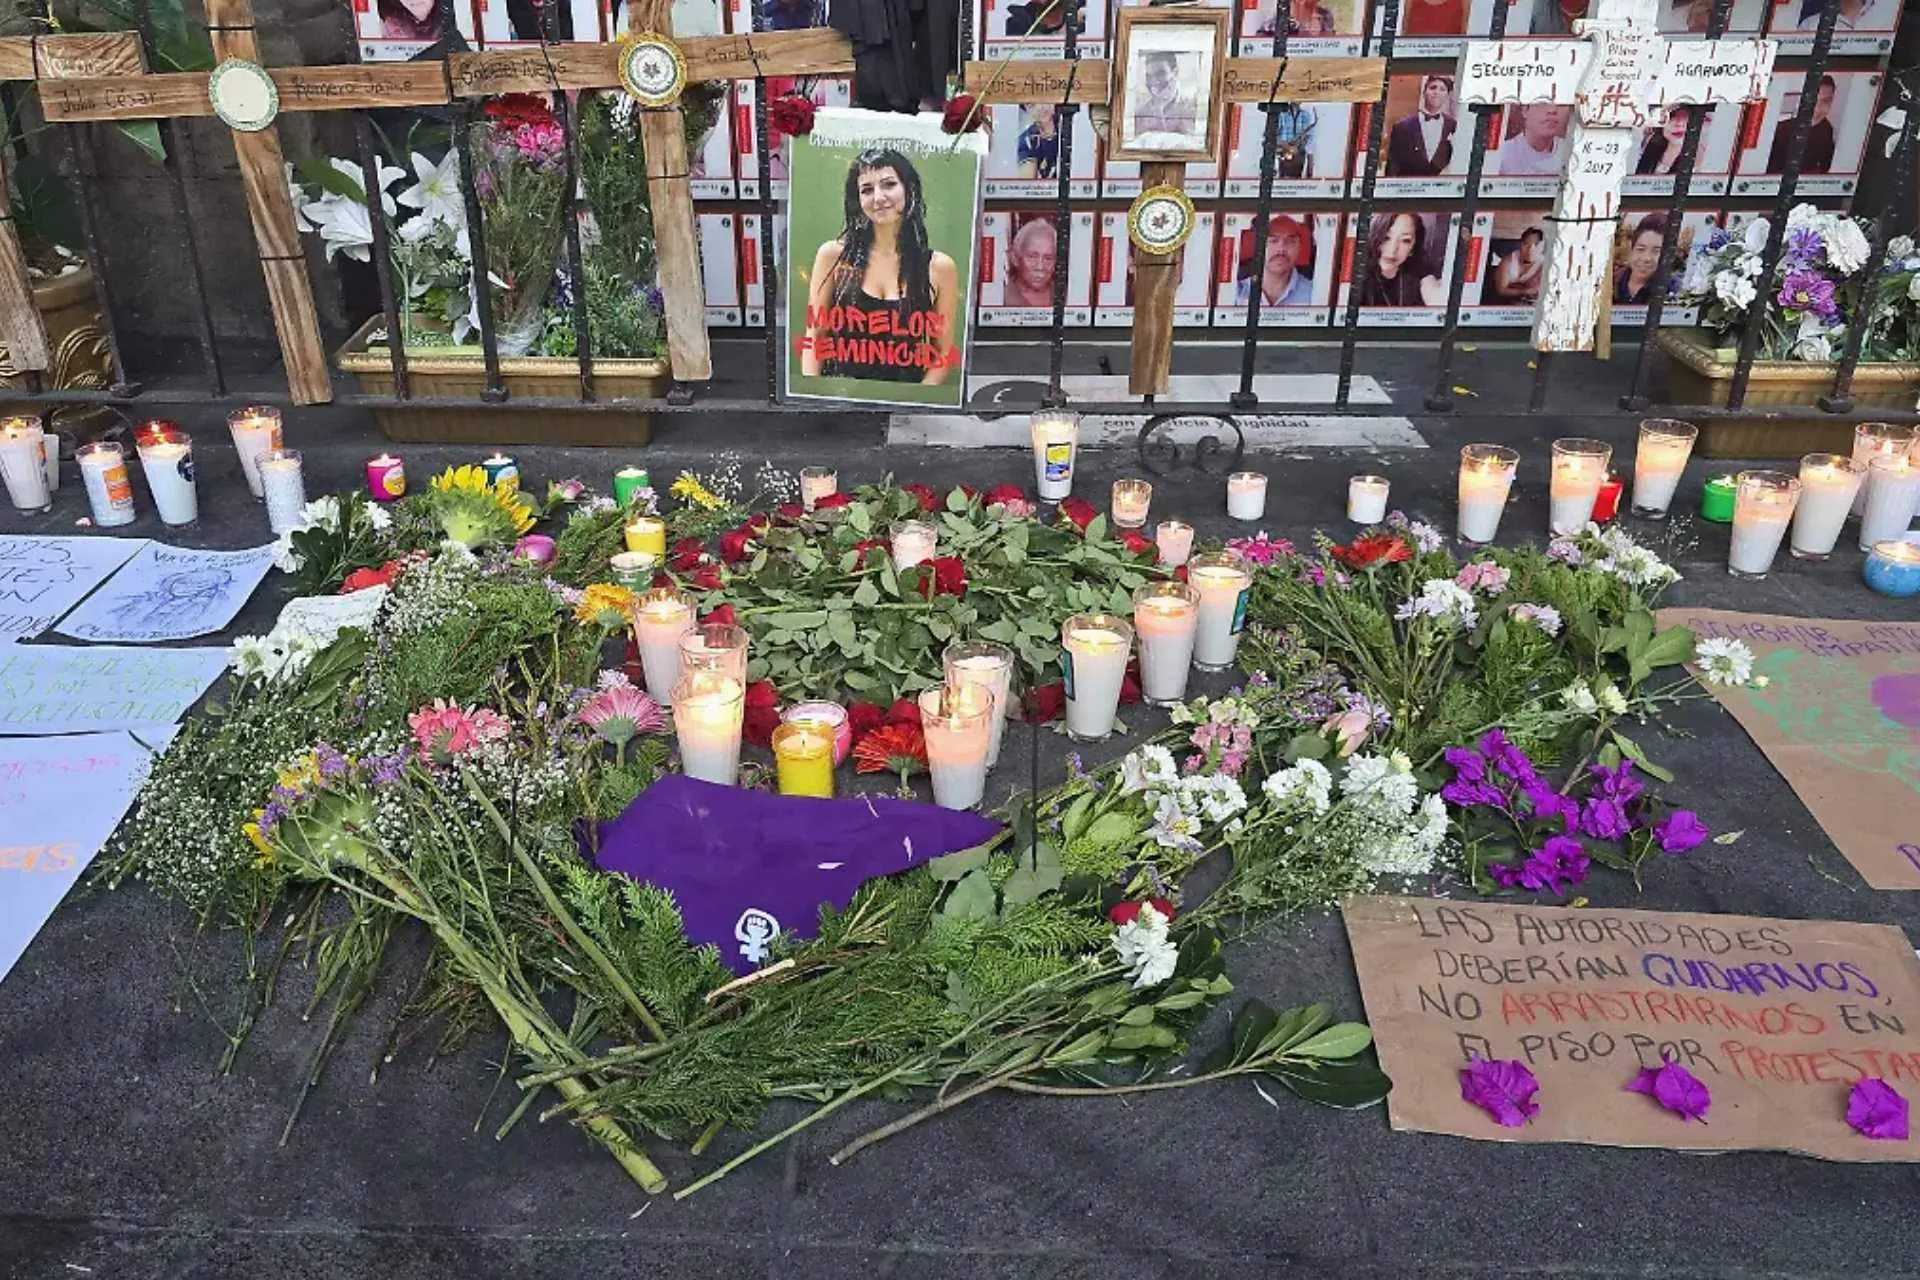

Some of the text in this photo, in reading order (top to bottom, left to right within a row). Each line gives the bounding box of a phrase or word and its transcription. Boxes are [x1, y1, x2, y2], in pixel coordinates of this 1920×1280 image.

[1023, 72, 1083, 96] Antono
[1583, 160, 1613, 175] 2017
[1411, 904, 1793, 957] LAS AUTORIDADES
[1433, 949, 1629, 986] DEBERÍAN
[1418, 984, 1907, 1037] NO ARRASTRARNOS EN
[1518, 1031, 1616, 1064] PISO
[1624, 1032, 1720, 1075] POR
